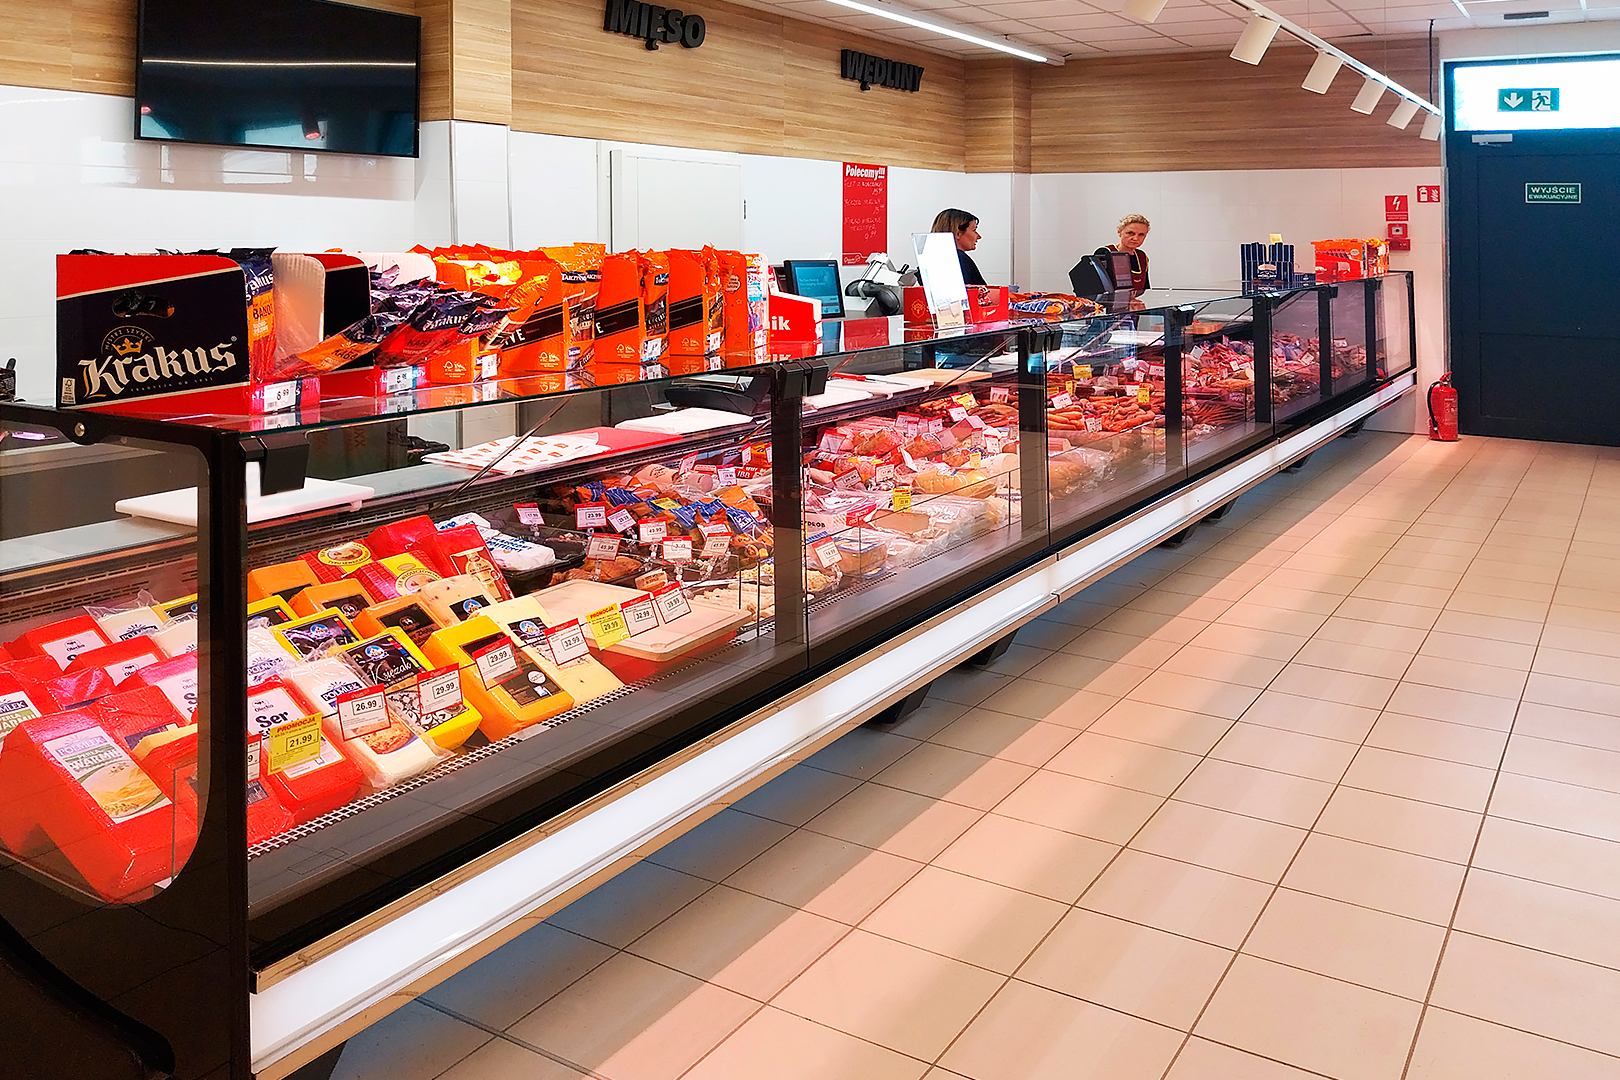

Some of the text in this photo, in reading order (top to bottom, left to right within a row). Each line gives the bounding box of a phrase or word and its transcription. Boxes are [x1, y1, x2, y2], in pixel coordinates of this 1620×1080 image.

[604, 0, 706, 50] MIĘSO
[841, 49, 925, 91] WĘDLINY
[845, 165, 885, 180] Polecamy!!!
[1531, 186, 1575, 194] WYJŚCIE
[78, 343, 237, 399] Krakus
[590, 606, 614, 619] PROMOCJA
[563, 635, 580, 648] 32.99
[489, 650, 508, 663] 29.99
[435, 682, 455, 695] 29.99
[355, 699, 378, 712] 26.99
[255, 710, 289, 728] Ser
[276, 717, 316, 733] PROMOCJA
[57, 736, 107, 756] POLMLEK
[289, 734, 313, 748] 21.99
